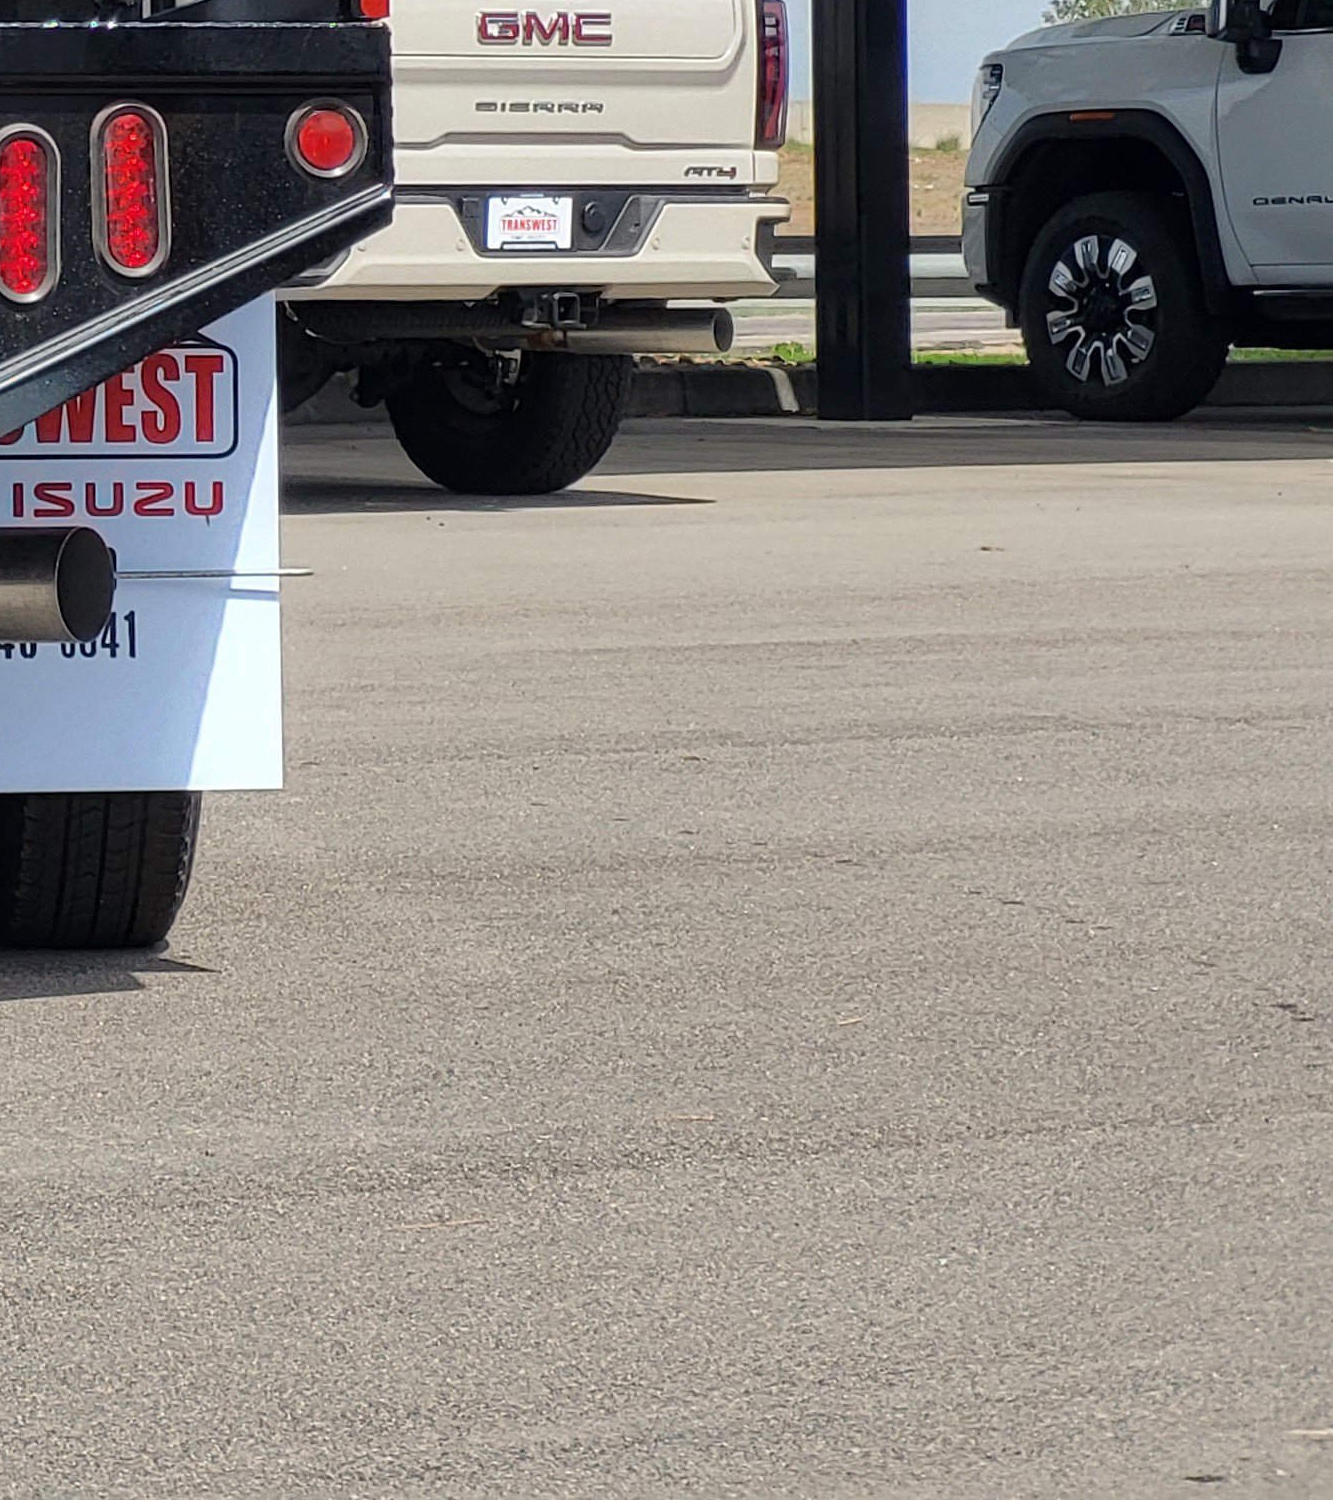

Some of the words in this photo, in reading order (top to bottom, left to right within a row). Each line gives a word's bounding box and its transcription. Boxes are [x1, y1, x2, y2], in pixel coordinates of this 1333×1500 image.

[475, 9, 613, 47] GMC
[475, 102, 604, 113] SIERRA
[684, 166, 737, 180] AT4
[501, 218, 558, 232] TRANSWEST
[12, 481, 224, 518] ISUZU
